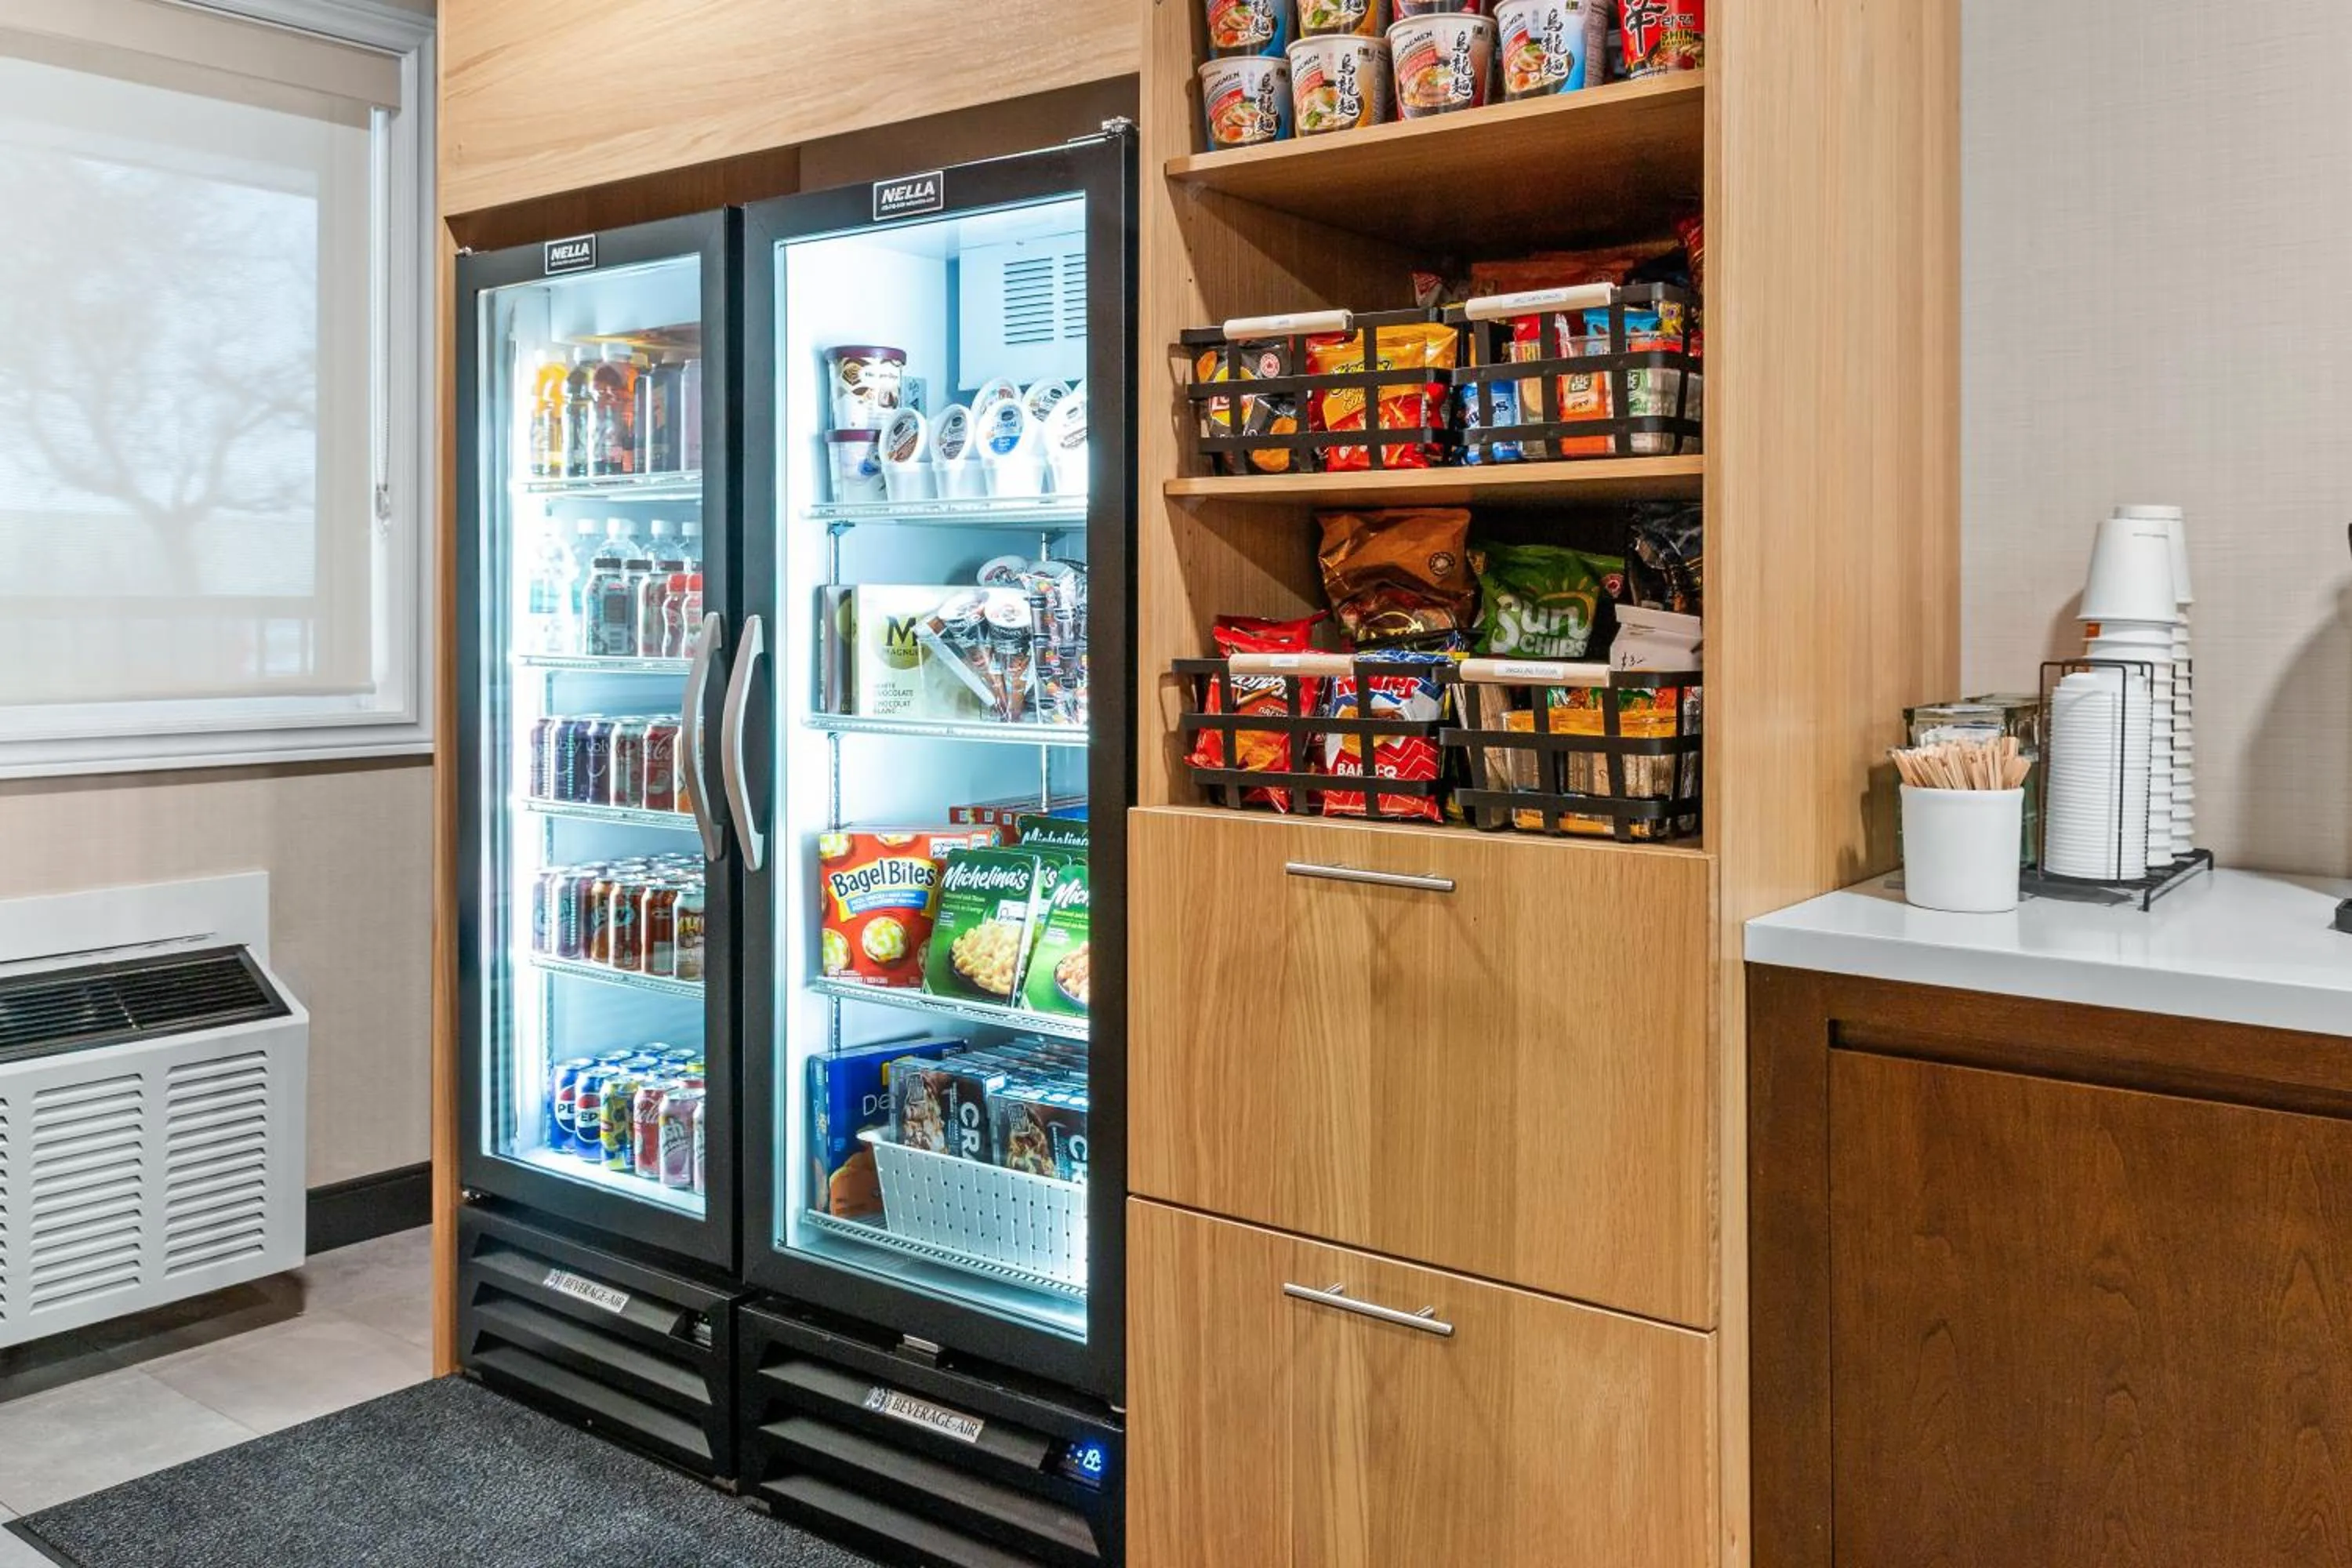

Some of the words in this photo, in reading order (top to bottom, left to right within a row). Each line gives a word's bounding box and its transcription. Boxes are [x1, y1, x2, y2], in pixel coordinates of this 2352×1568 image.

[1661, 30, 1693, 40] SHIN
[880, 180, 935, 204] NELLA
[551, 242, 590, 260] NELLA
[1627, 371, 1640, 382] ic
[1520, 633, 1588, 657] CHIPS
[831, 859, 885, 897] Bagel
[887, 860, 935, 886] Bites
[942, 862, 1029, 891] Michelina's
[892, 1398, 978, 1436] BEVERAGE-AIR
